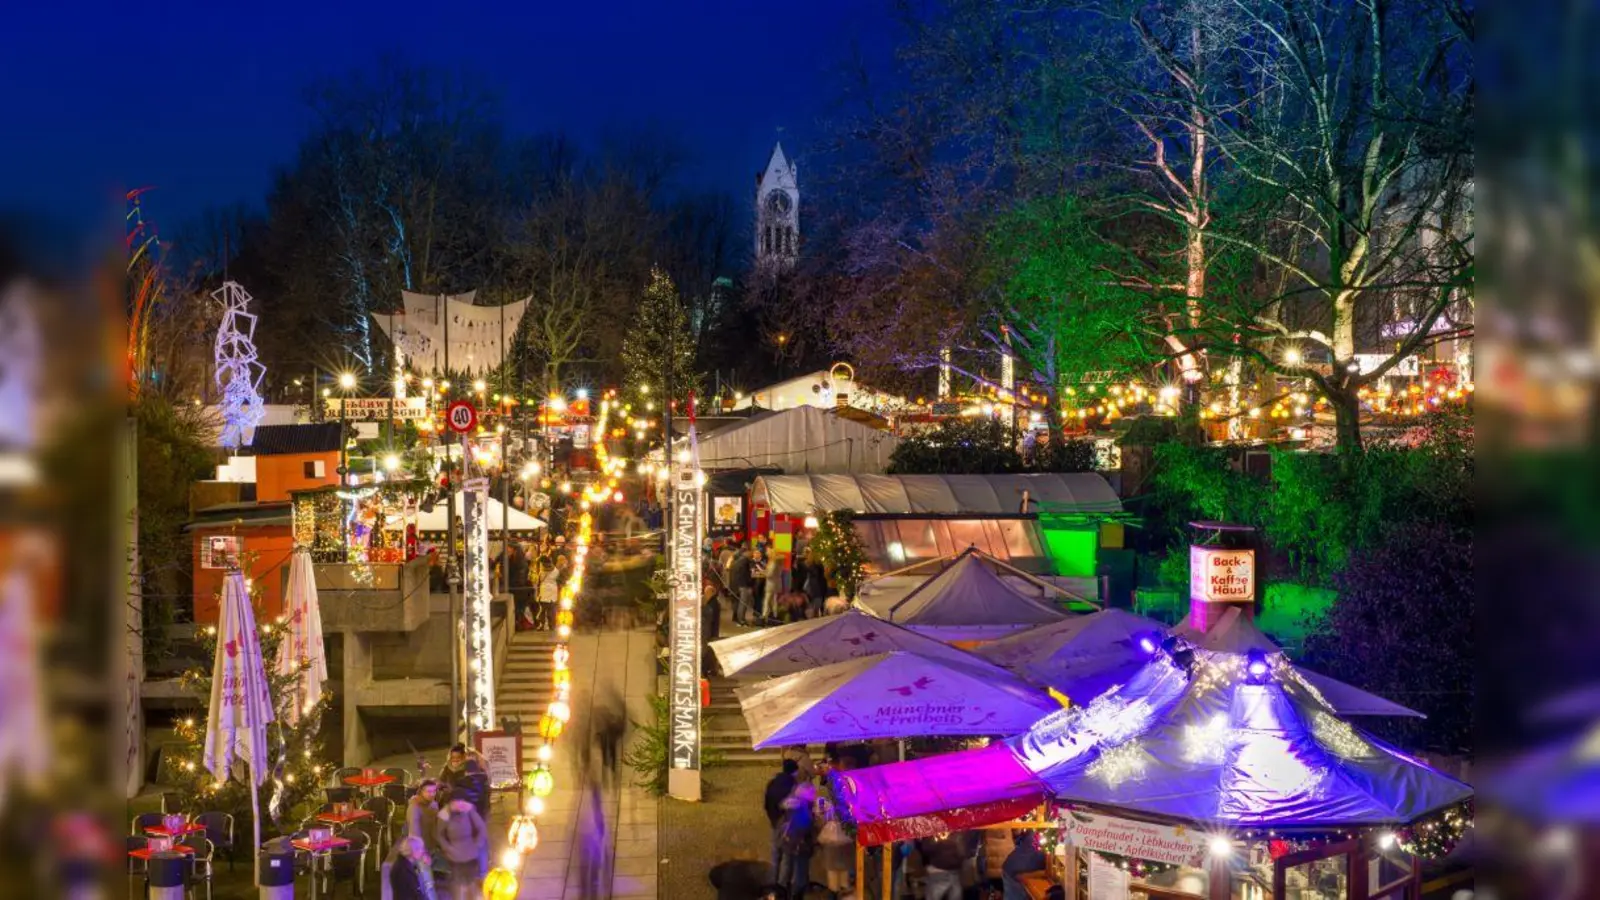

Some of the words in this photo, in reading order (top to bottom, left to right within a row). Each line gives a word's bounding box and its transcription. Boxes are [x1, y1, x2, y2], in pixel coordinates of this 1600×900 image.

[453, 408, 470, 425] 40
[1213, 556, 1247, 567] Back-
[673, 606, 697, 769] WEIHNACHTSMARKT
[1076, 823, 1135, 842] Dampfnudel
[1141, 834, 1194, 853] Lebkuchen
[1083, 836, 1117, 851] Strudel
